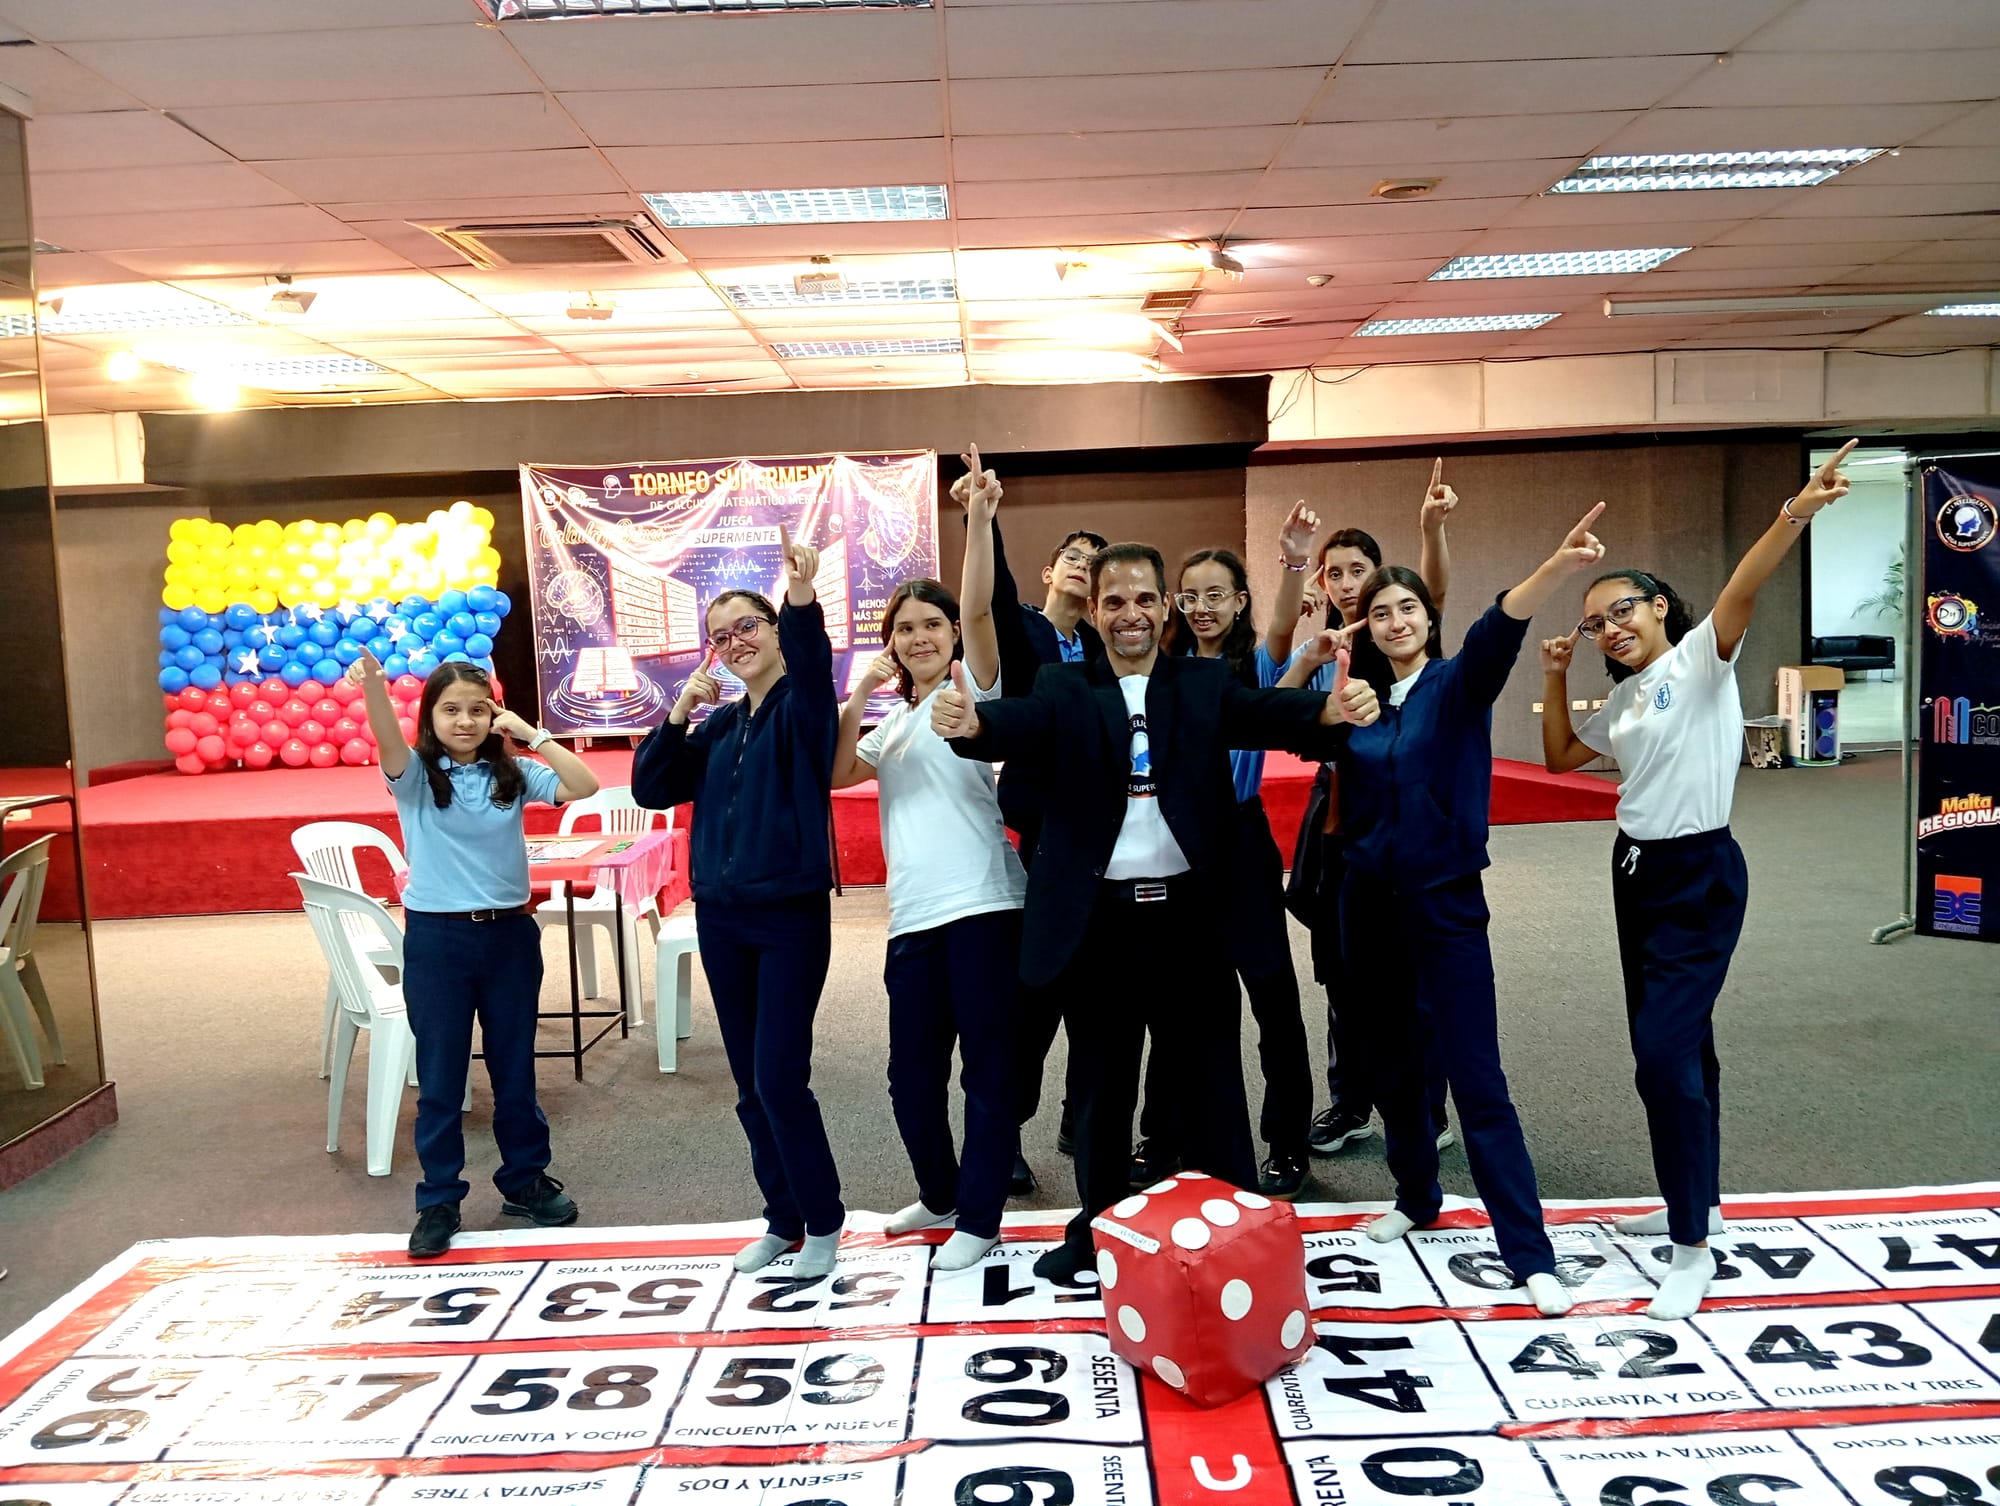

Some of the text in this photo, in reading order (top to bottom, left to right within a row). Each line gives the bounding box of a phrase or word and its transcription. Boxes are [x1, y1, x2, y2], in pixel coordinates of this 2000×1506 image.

[629, 470, 710, 496] TORNEO
[717, 515, 753, 527] JUEGA
[694, 530, 776, 544] SUPERMENTE
[857, 599, 887, 609] MENOS
[853, 610, 871, 621] MÁS
[1132, 783, 1156, 793] SUPER
[1941, 793, 1993, 814] Malta
[1918, 806, 2000, 837] REGIONA
[1728, 1224, 1794, 1233] CUARE
[1824, 1223, 1873, 1231] SIETE
[1890, 1217, 1988, 1227] CUARENTA
[1304, 1238, 1357, 1249] CINC
[1417, 1236, 1480, 1245] NUEVE
[766, 1258, 794, 1266] DO
[981, 1249, 1005, 1257] UN
[1878, 1234, 2000, 1272] 47
[438, 1269, 524, 1279] CINCUENTA
[557, 1267, 598, 1275] TRES
[621, 1263, 721, 1272] CINCUENTA
[1306, 1254, 1382, 1295] 5
[539, 1278, 704, 1322] 53
[747, 1271, 905, 1312] 52
[330, 1287, 501, 1330] 54
[1508, 1329, 1706, 1380] 42
[1745, 1321, 1932, 1371] 43
[705, 1353, 886, 1407] 59
[1313, 1334, 1434, 1414] 41
[470, 1365, 659, 1415] 58
[962, 1346, 1070, 1427] 60
[1091, 1355, 1121, 1419] SESENTA
[1774, 1379, 1984, 1397] CUARENTA Y TRES
[1279, 1364, 1313, 1431] CUARENTA
[1525, 1390, 1743, 1410] CUARENTA Y DOS
[430, 1430, 648, 1444] CINCUENTA Y OCHO
[675, 1420, 899, 1436] CINCUENTA Y NUEVE
[1833, 1438, 1909, 1449] OCHO
[1914, 1437, 1934, 1447] Y
[1560, 1445, 1783, 1460] TREINTA Y NUEVE
[678, 1471, 864, 1491] SESENTA Y DOS
[1103, 1455, 1126, 1506] SESENT
[1360, 1447, 1484, 1506] 0
[411, 1479, 607, 1499] SESENTA Y TRES
